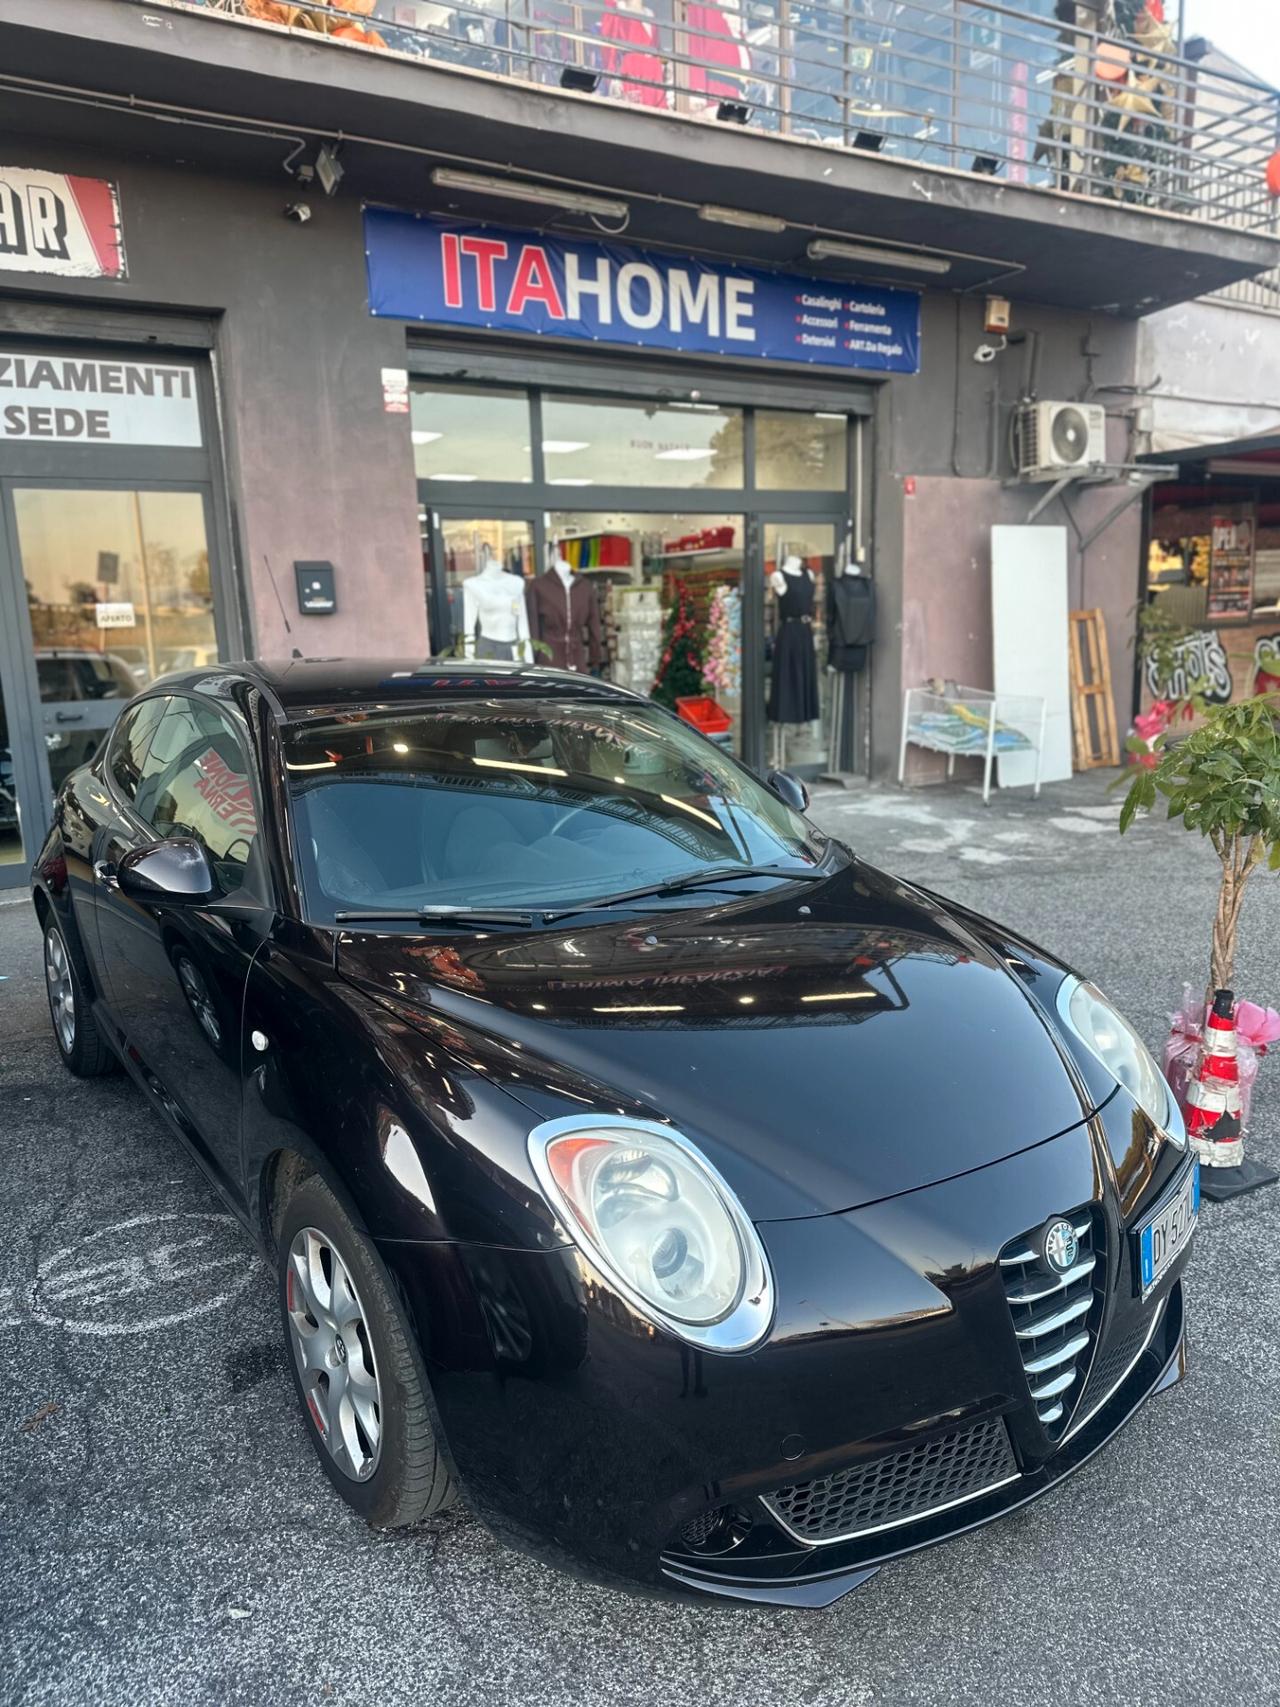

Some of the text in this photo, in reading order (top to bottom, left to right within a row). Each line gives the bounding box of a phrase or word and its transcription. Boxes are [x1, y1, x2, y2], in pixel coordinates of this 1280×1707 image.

[441, 233, 756, 341] ITAHOME
[802, 295, 842, 311] Casalinghi
[849, 301, 885, 315] Cartoleria
[801, 314, 838, 328] Accessori
[849, 320, 892, 336] Ferramenta
[801, 333, 836, 348] Detersivi
[4, 405, 110, 439] SEDE
